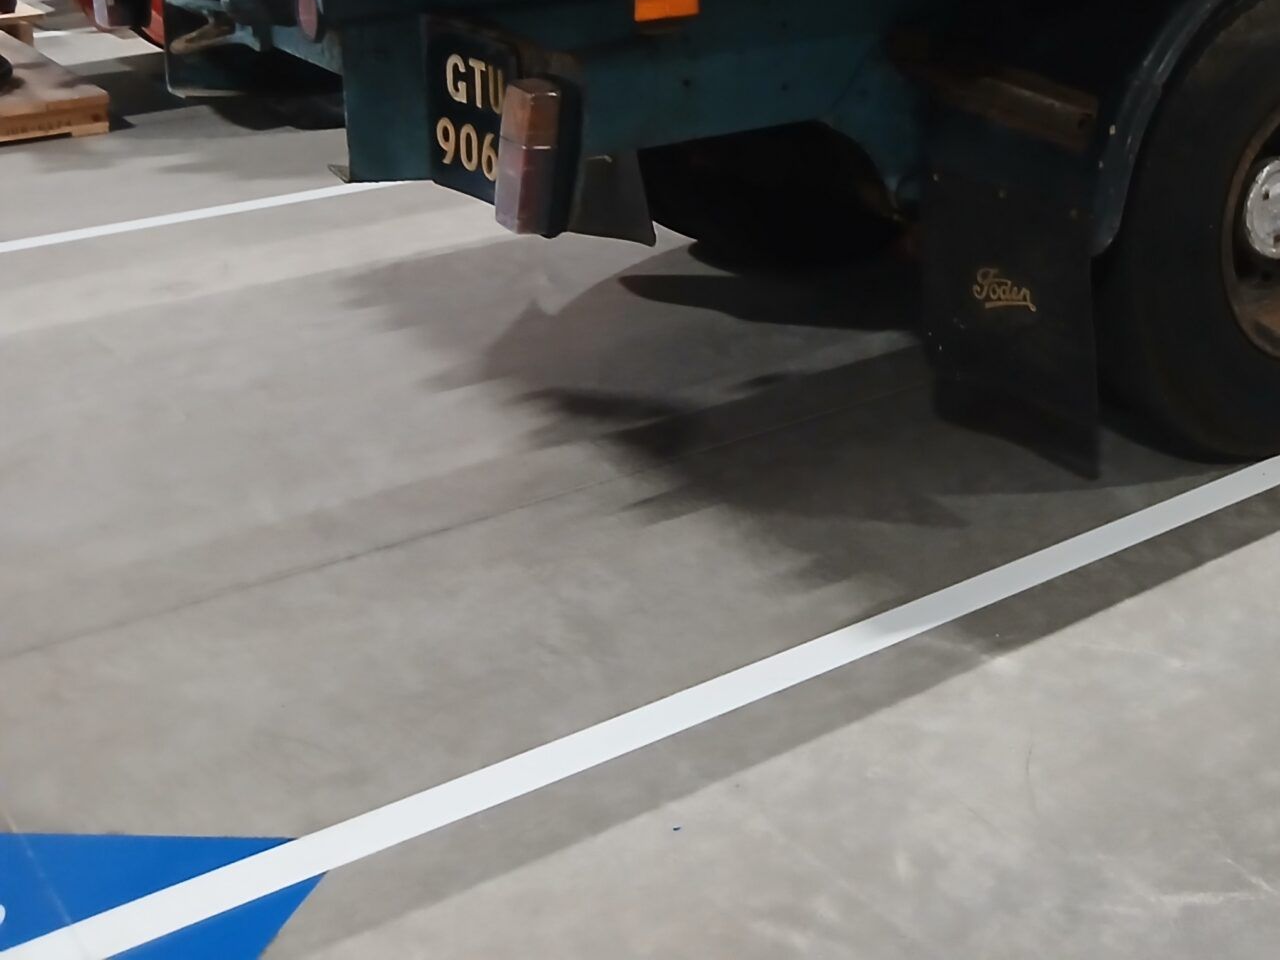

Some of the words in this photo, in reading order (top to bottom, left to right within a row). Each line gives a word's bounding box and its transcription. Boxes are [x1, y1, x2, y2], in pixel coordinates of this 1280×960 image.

[446, 53, 504, 115] GTU
[436, 117, 499, 182] 906
[973, 267, 1037, 312] Foden
